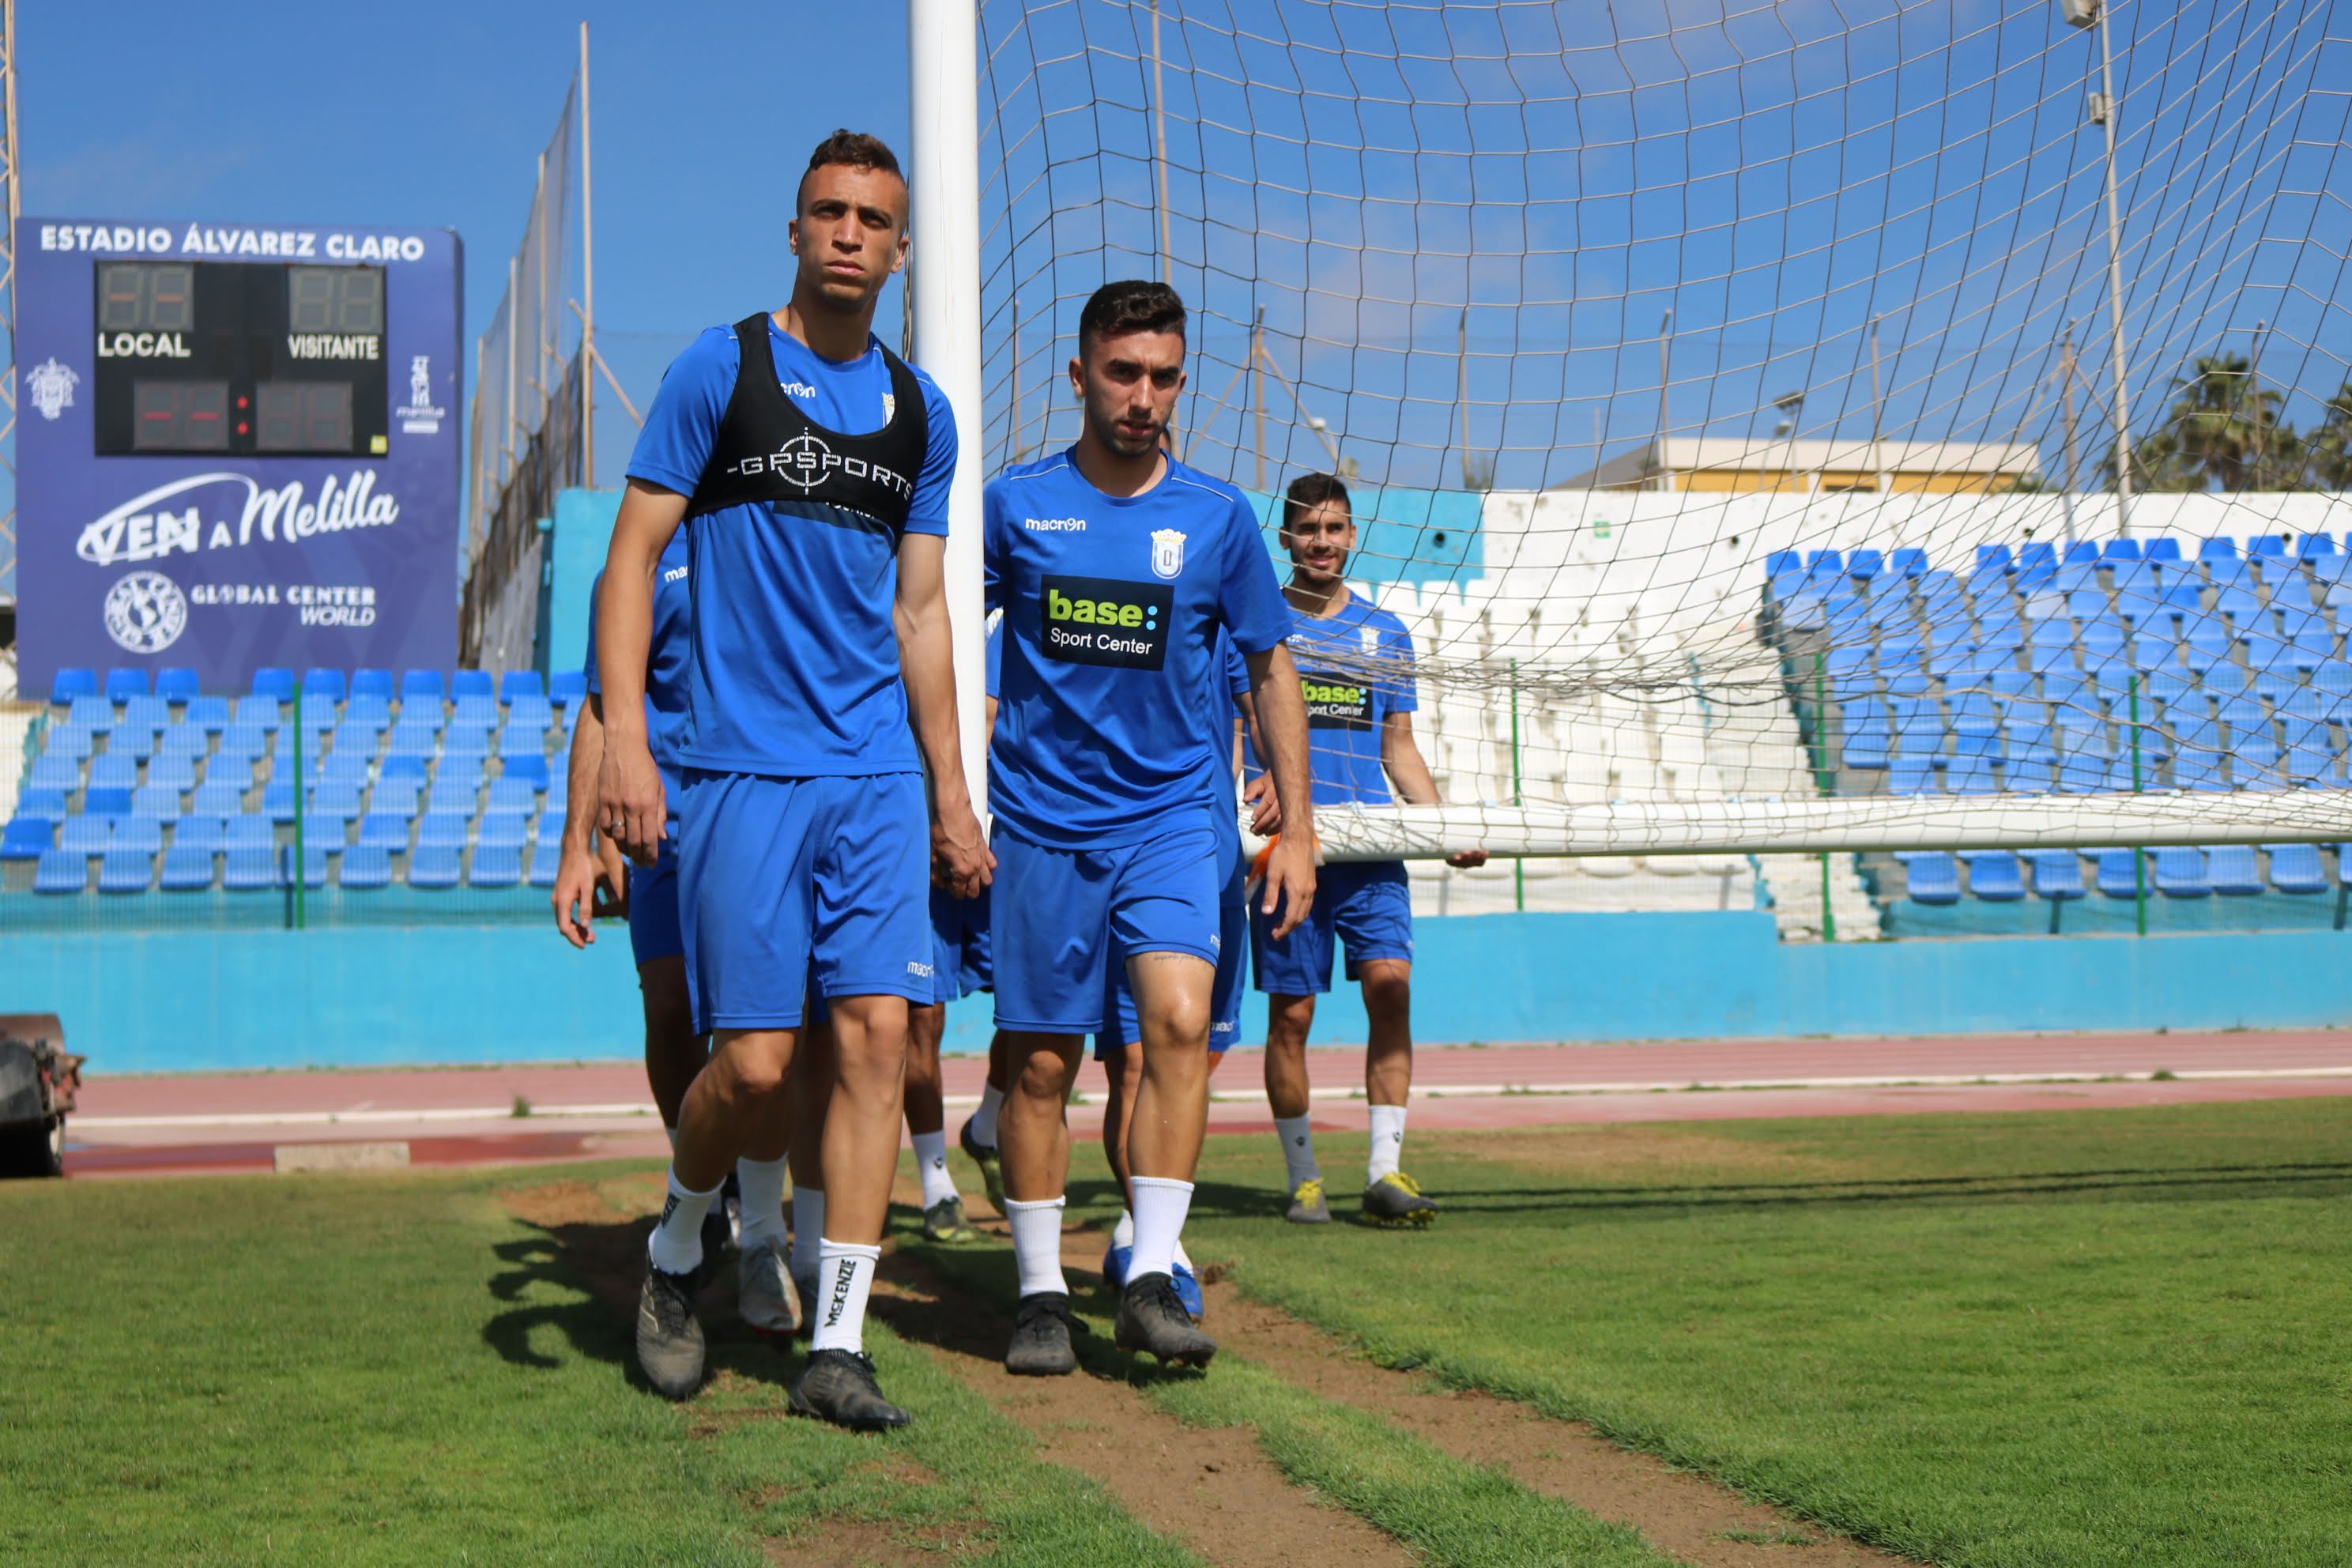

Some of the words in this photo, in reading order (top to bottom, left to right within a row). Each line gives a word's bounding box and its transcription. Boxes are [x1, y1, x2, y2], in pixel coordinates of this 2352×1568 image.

[40, 225, 172, 252] ESTADIO
[182, 222, 316, 257] ÁLVAREZ
[326, 236, 425, 262] CLARO
[97, 333, 190, 358] LOCAL
[288, 334, 379, 360] VISITANTE
[83, 508, 200, 567] VEN
[209, 522, 232, 550] A
[239, 469, 400, 545] Melilla
[191, 585, 279, 605] GLOBAL
[287, 586, 376, 606] CENTER
[300, 606, 376, 627] WORLD
[1050, 628, 1093, 650] Sport
[1096, 635, 1153, 656] Center
